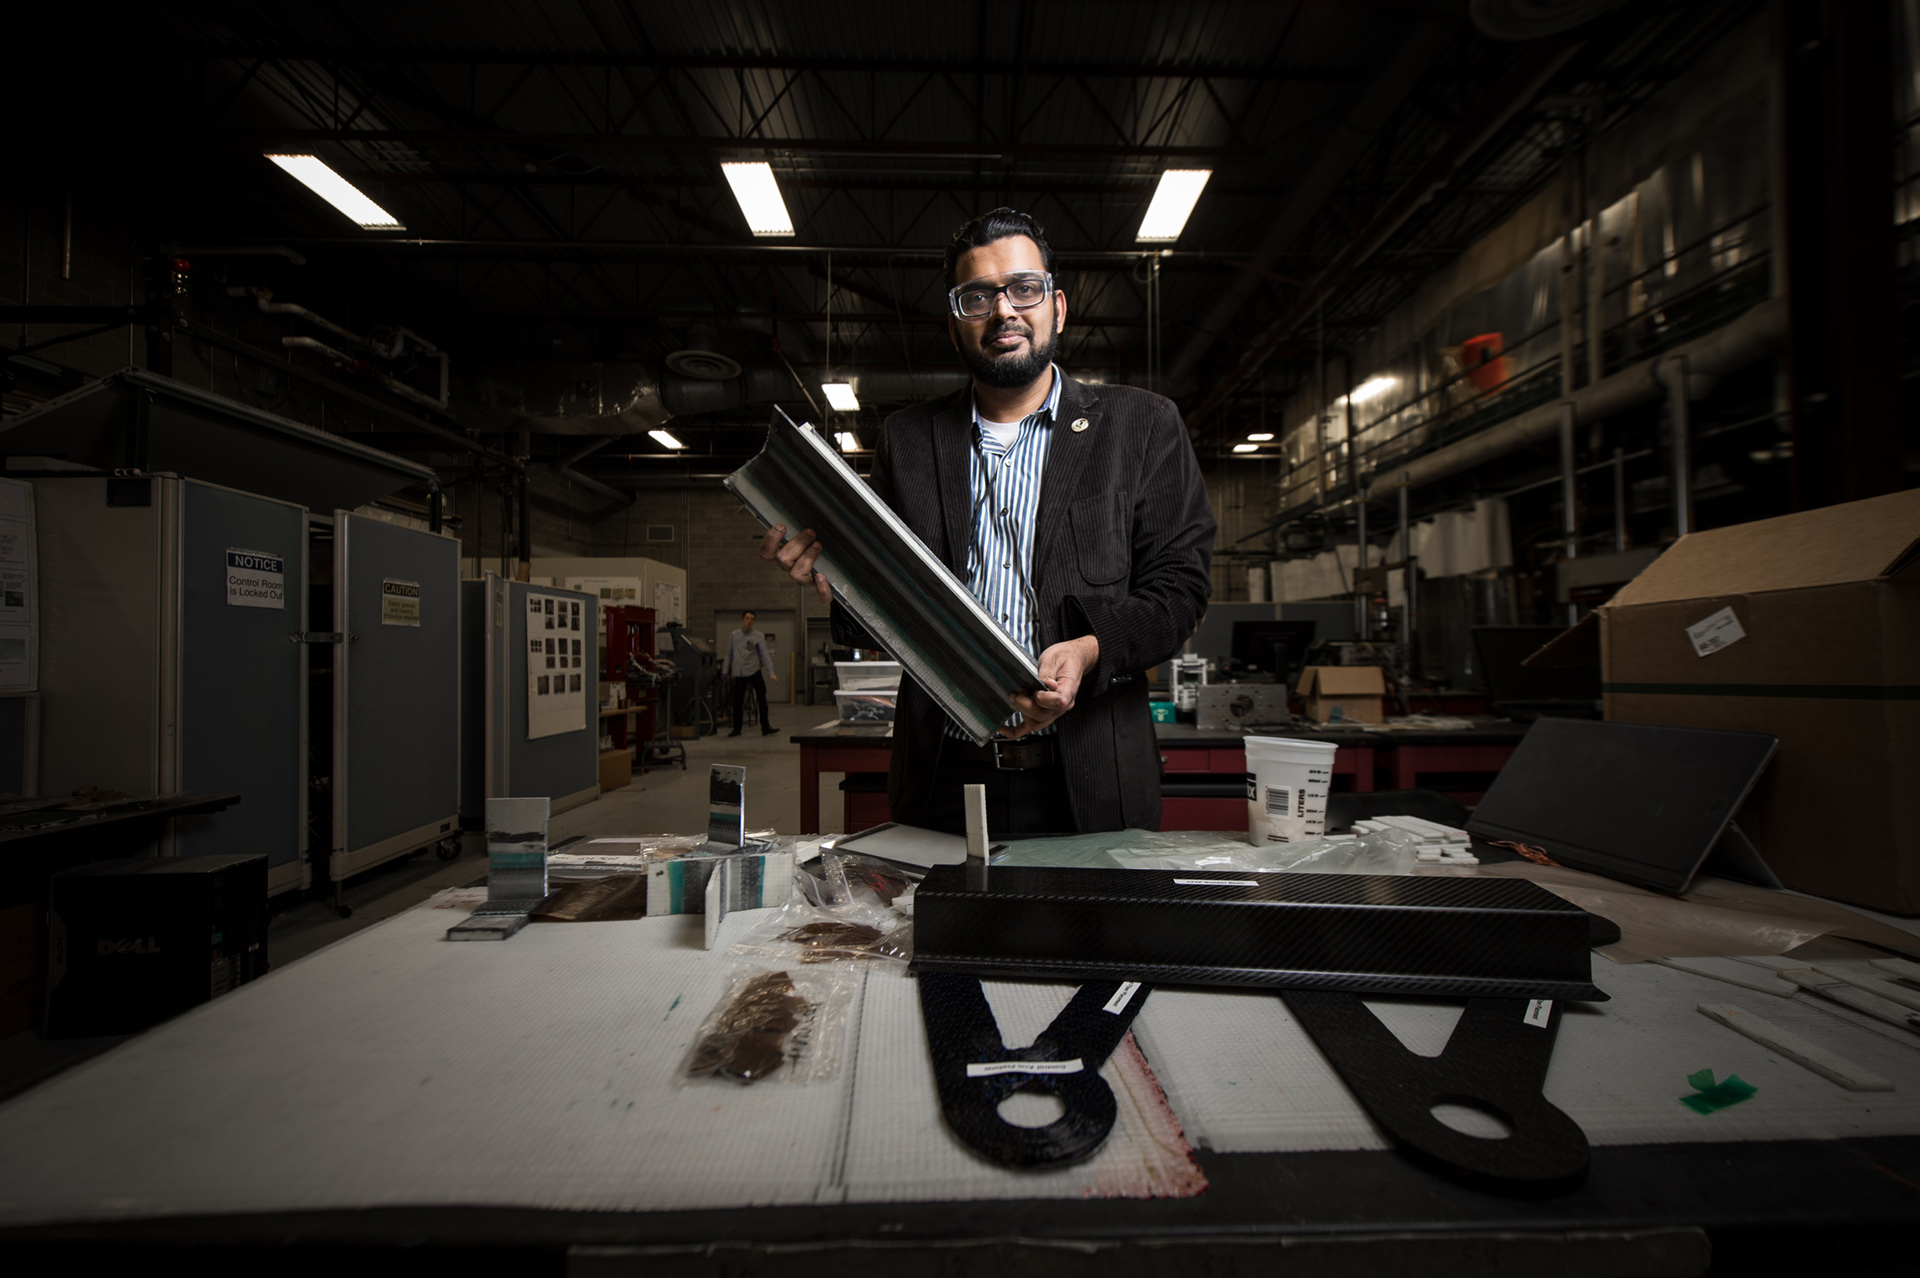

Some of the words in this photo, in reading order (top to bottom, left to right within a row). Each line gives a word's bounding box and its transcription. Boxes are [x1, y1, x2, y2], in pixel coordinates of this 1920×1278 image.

[235, 555, 278, 571] NOTICE
[229, 576, 260, 587] Control
[261, 579, 282, 590] Room
[384, 584, 418, 596] CAUTION
[230, 586, 237, 596] is
[239, 587, 268, 598] Locked
[270, 590, 283, 600] Out
[1297, 789, 1305, 817] LITERS
[96, 936, 161, 957] DELL
